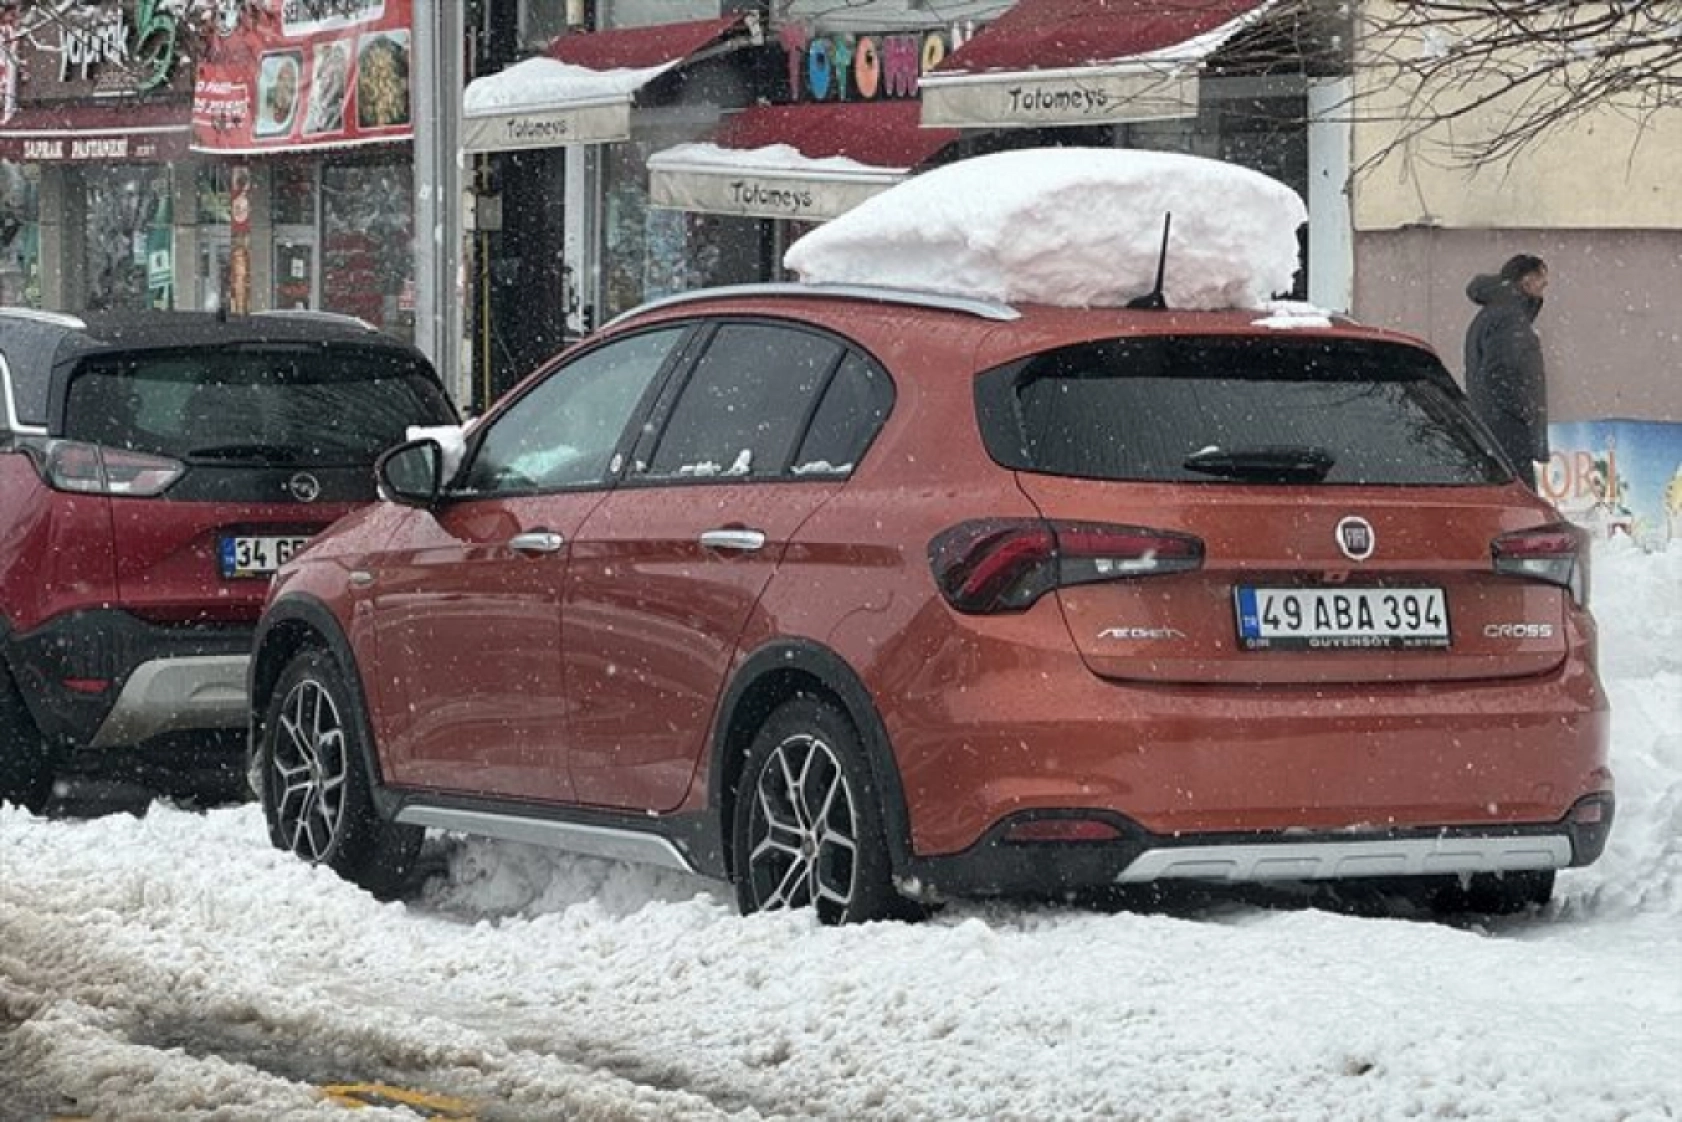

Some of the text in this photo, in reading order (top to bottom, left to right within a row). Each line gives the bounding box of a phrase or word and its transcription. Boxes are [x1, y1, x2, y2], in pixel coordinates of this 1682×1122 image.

[1008, 85, 1108, 113] Totomeys
[731, 181, 813, 213] Totomeys
[237, 540, 266, 567] 34
[1263, 595, 1442, 630] 49 ABA 394
[1483, 623, 1554, 638] CROSS
